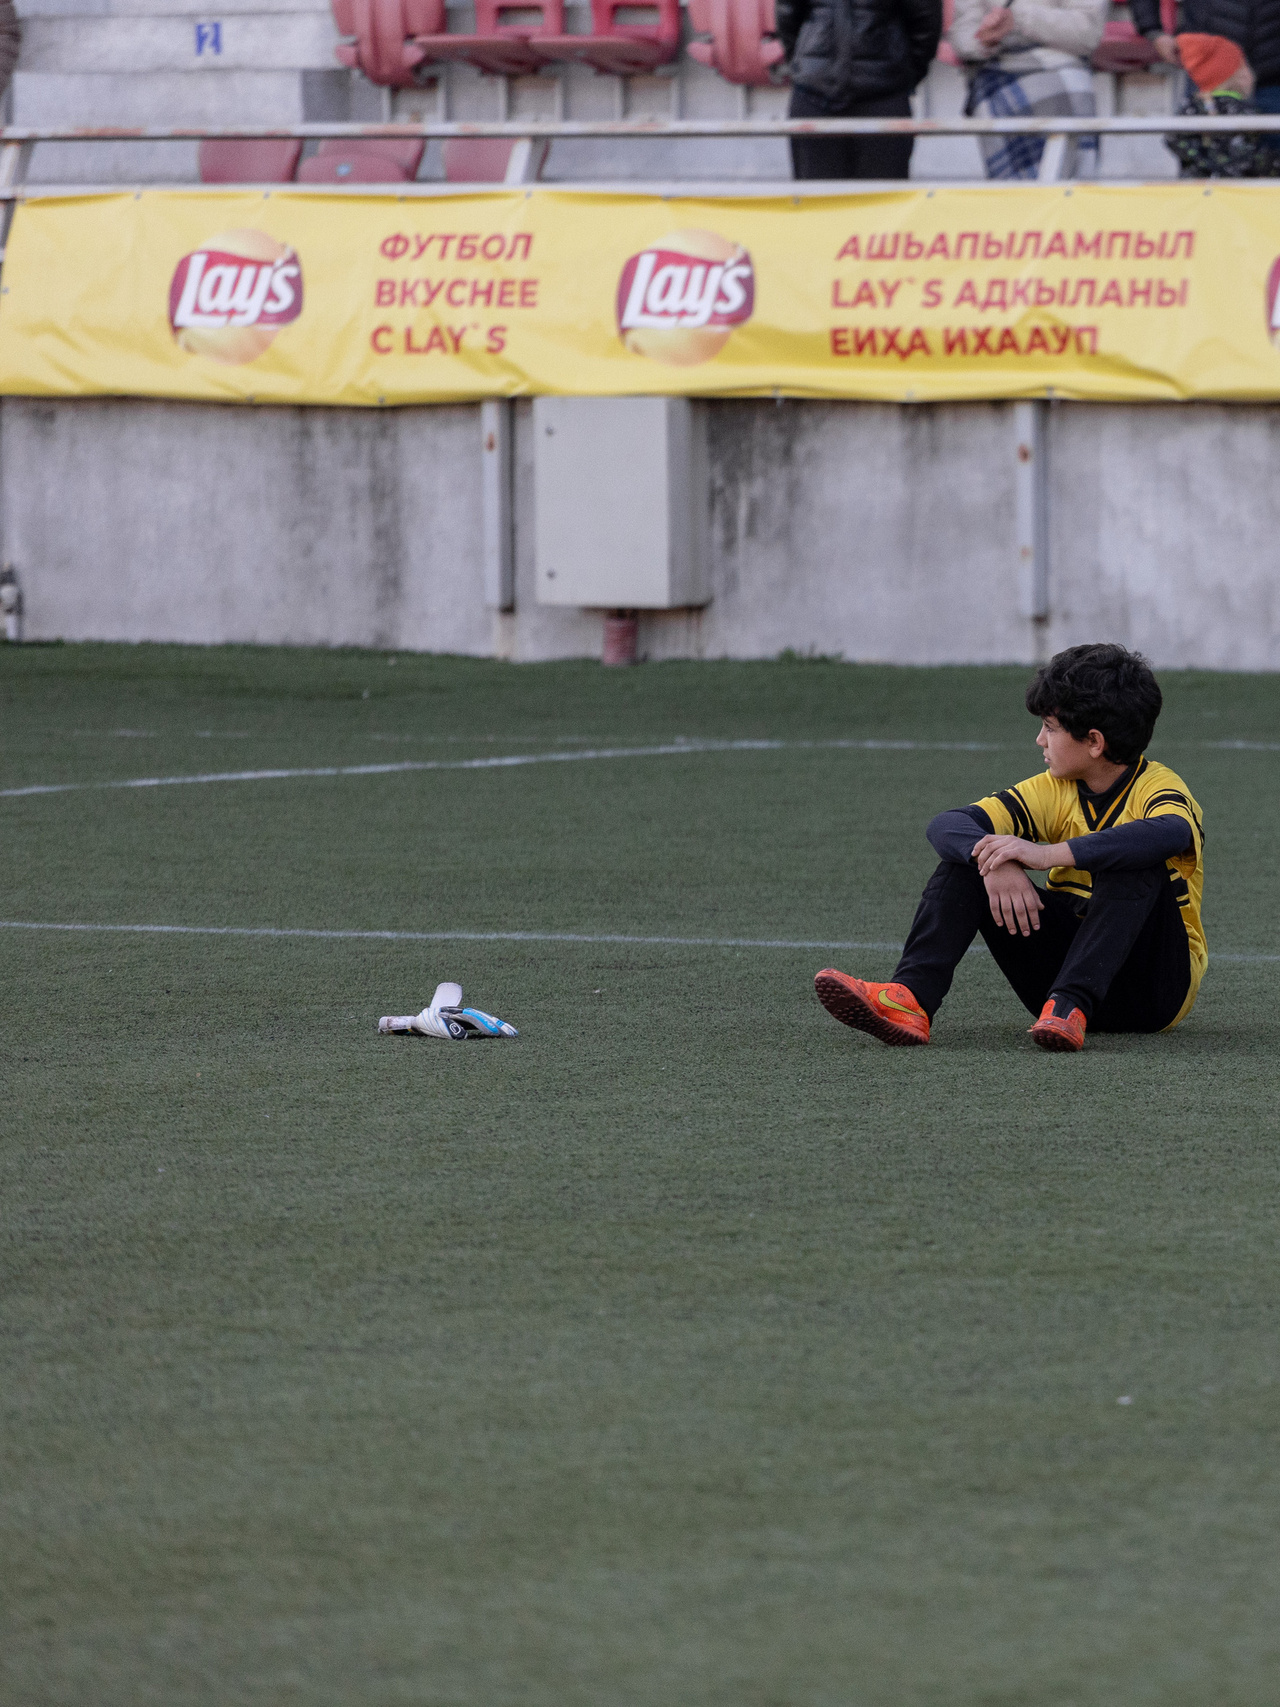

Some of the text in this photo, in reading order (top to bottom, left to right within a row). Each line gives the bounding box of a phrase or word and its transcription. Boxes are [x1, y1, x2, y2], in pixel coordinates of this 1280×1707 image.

[380, 233, 533, 261] ФУТБОЛ
[835, 231, 1195, 261] АШЬАПЫЛАМПЫЛ
[174, 253, 299, 328] Lay's
[374, 278, 539, 308] ВКУСНЕЕ
[621, 253, 751, 329] Lay's
[952, 277, 1188, 313] АДКЫЛАНЫ
[370, 325, 394, 355] С
[942, 325, 1099, 357] ИХААУП
